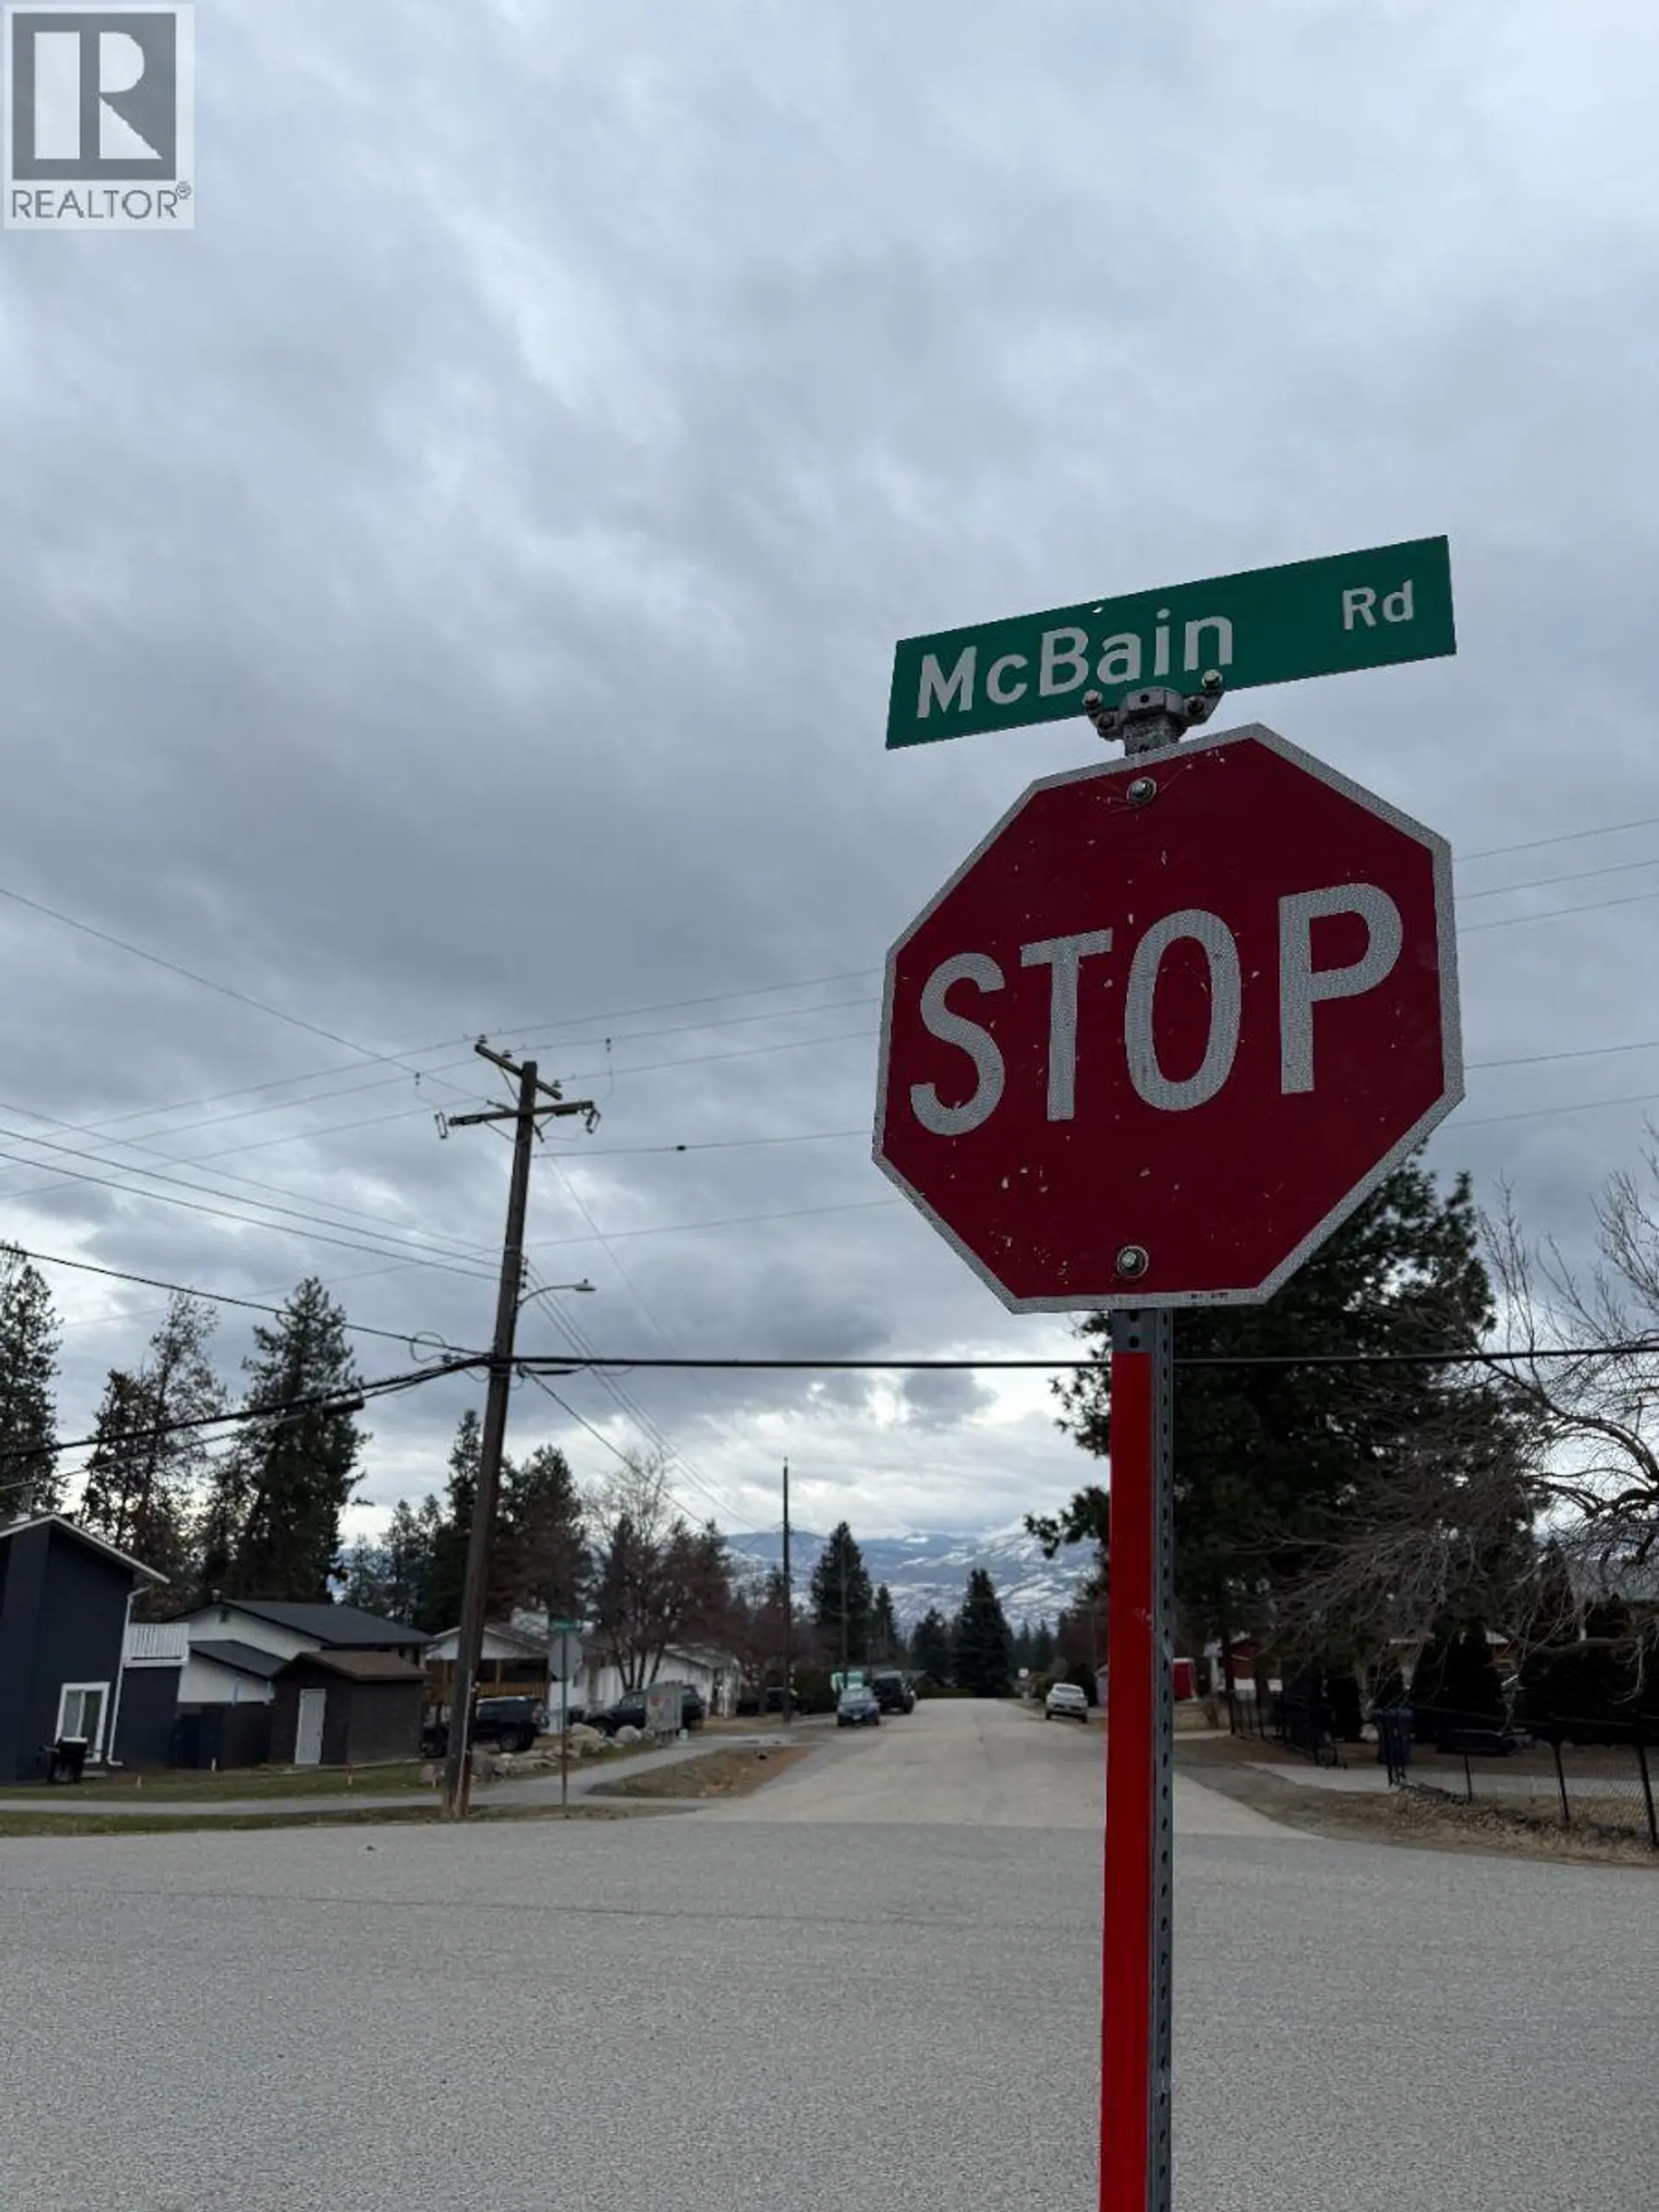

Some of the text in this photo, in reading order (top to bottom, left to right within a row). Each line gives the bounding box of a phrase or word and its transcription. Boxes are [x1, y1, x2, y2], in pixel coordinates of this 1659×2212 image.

[916, 579, 1414, 719] McBain Rd
[910, 883, 1404, 1136] STOP
